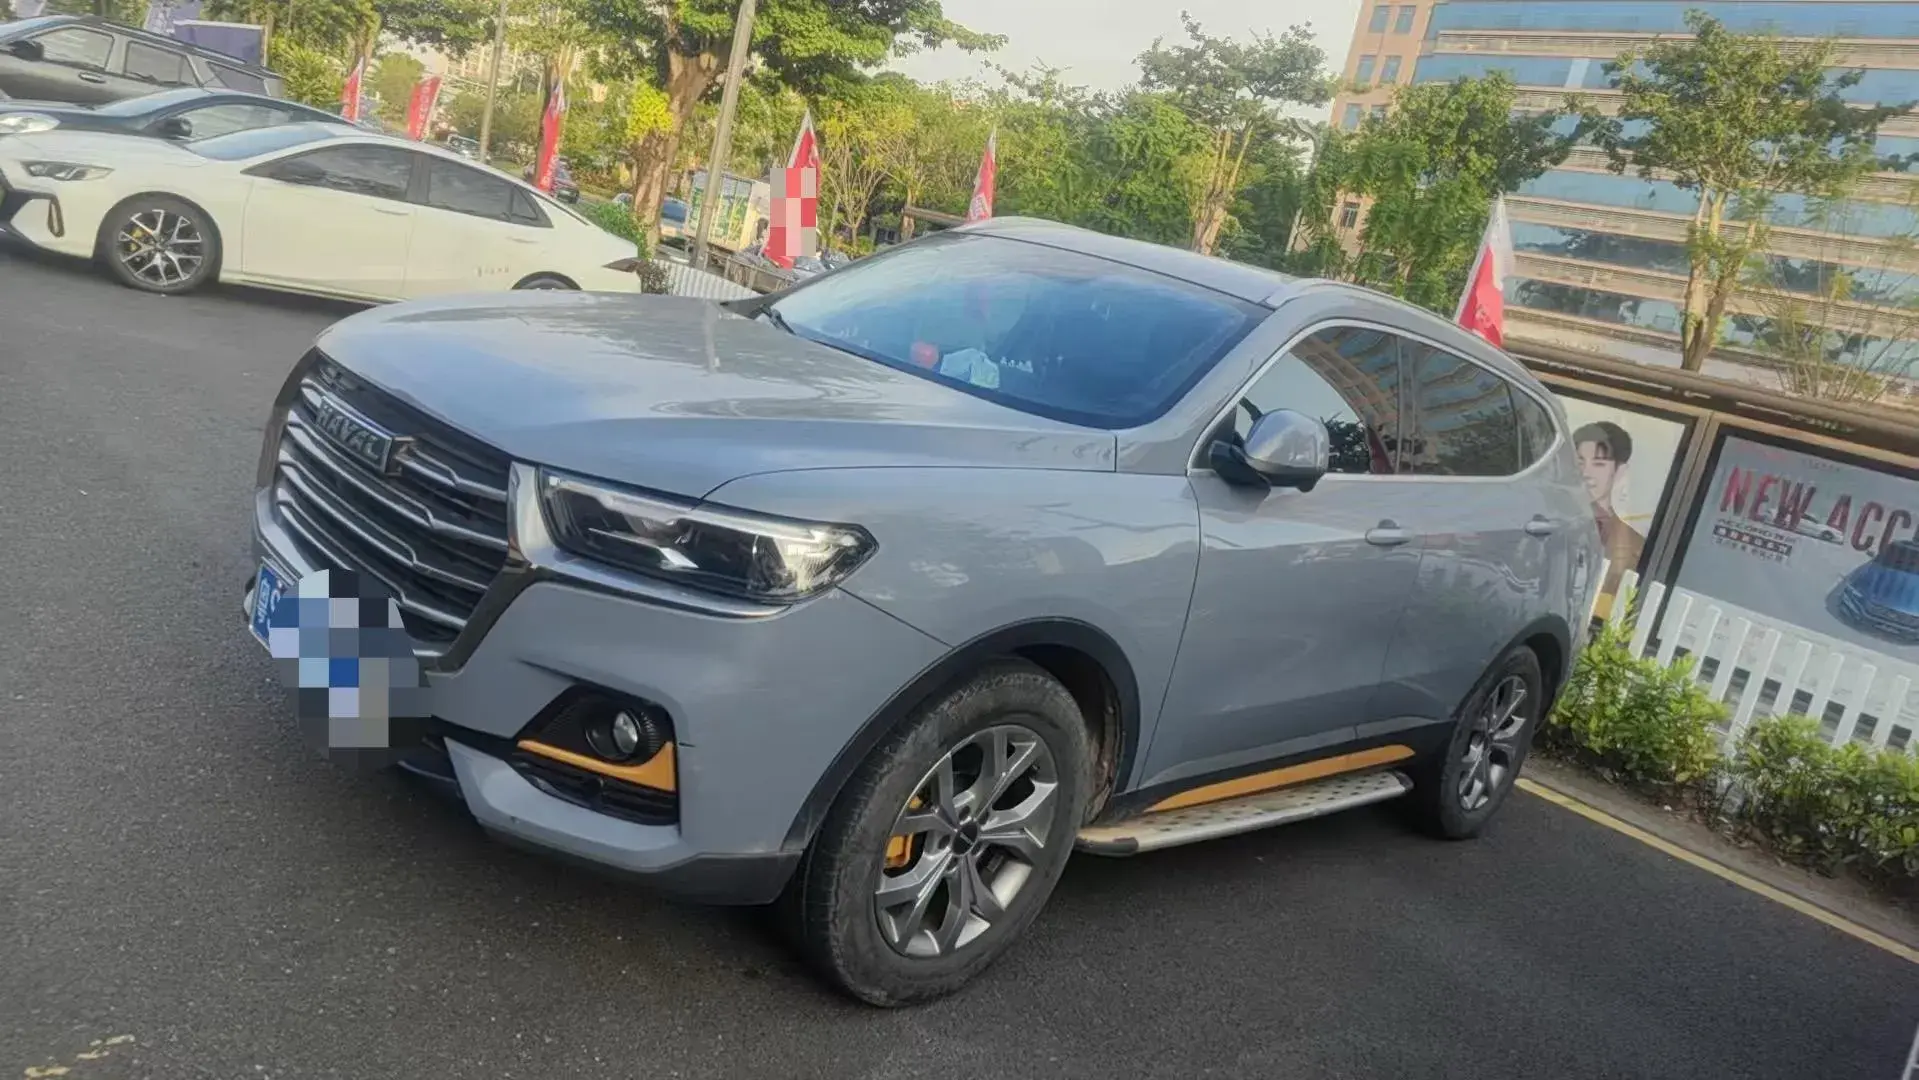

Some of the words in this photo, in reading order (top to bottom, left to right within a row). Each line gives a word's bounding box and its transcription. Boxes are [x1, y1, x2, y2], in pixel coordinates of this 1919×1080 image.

[317, 404, 379, 461] HAVAL
[1719, 465, 1817, 531] NEW
[1826, 493, 1919, 553] ACC
